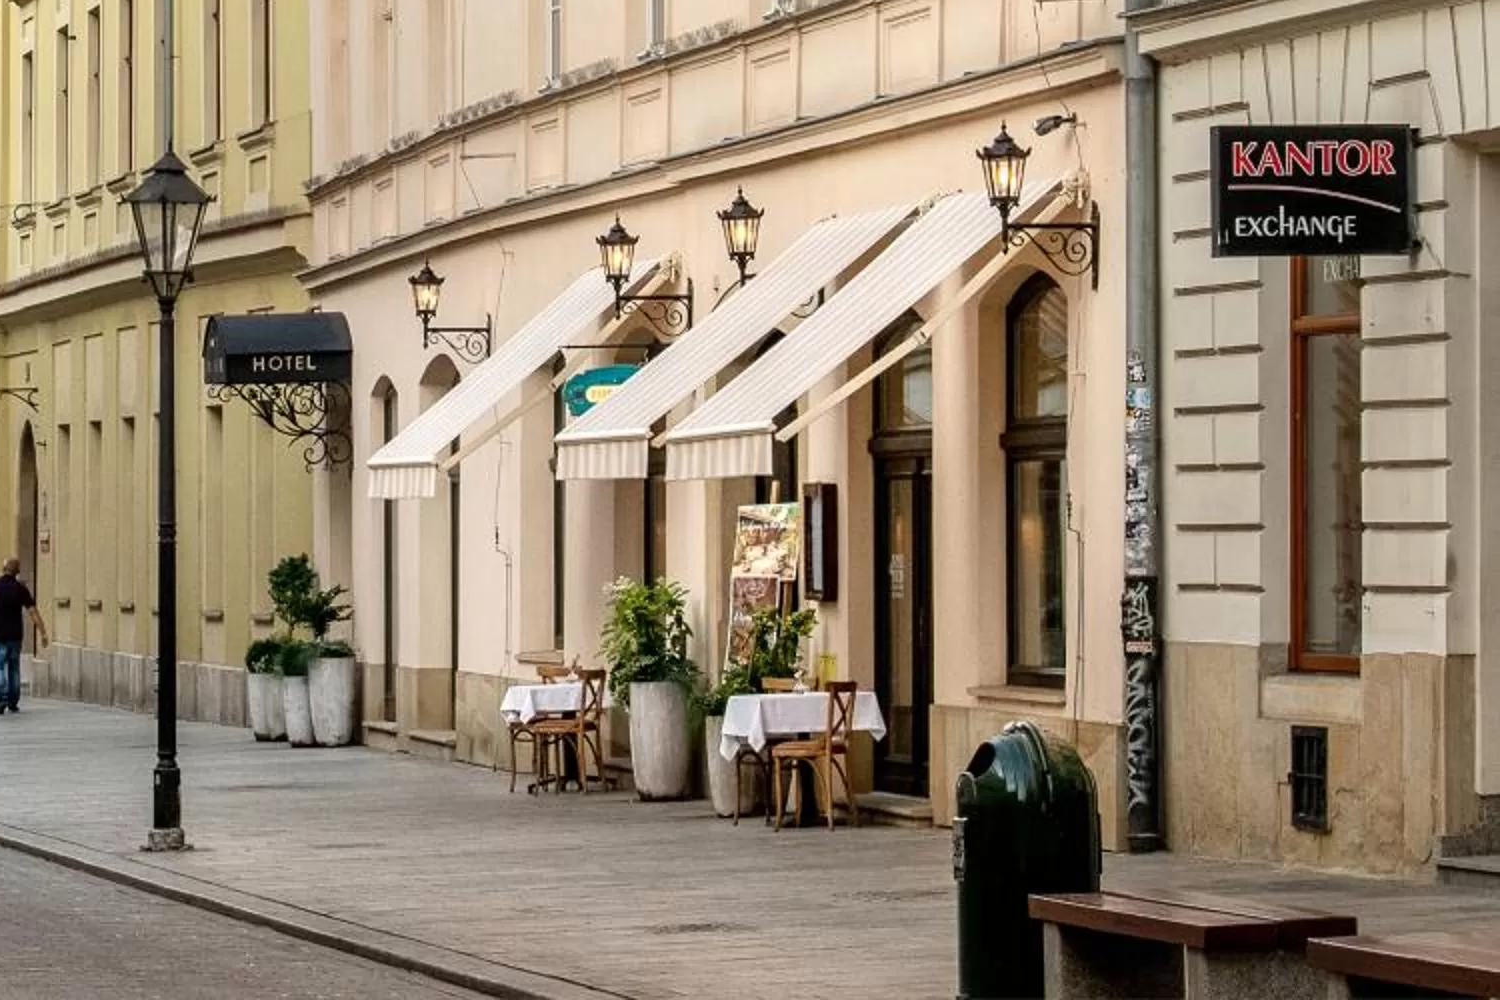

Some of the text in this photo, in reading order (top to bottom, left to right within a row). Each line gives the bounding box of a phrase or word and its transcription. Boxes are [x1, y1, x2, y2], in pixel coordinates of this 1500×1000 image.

[1232, 139, 1396, 177] KANTOR
[1235, 205, 1357, 244] EXCHANGE
[252, 355, 317, 372] HOTEL
